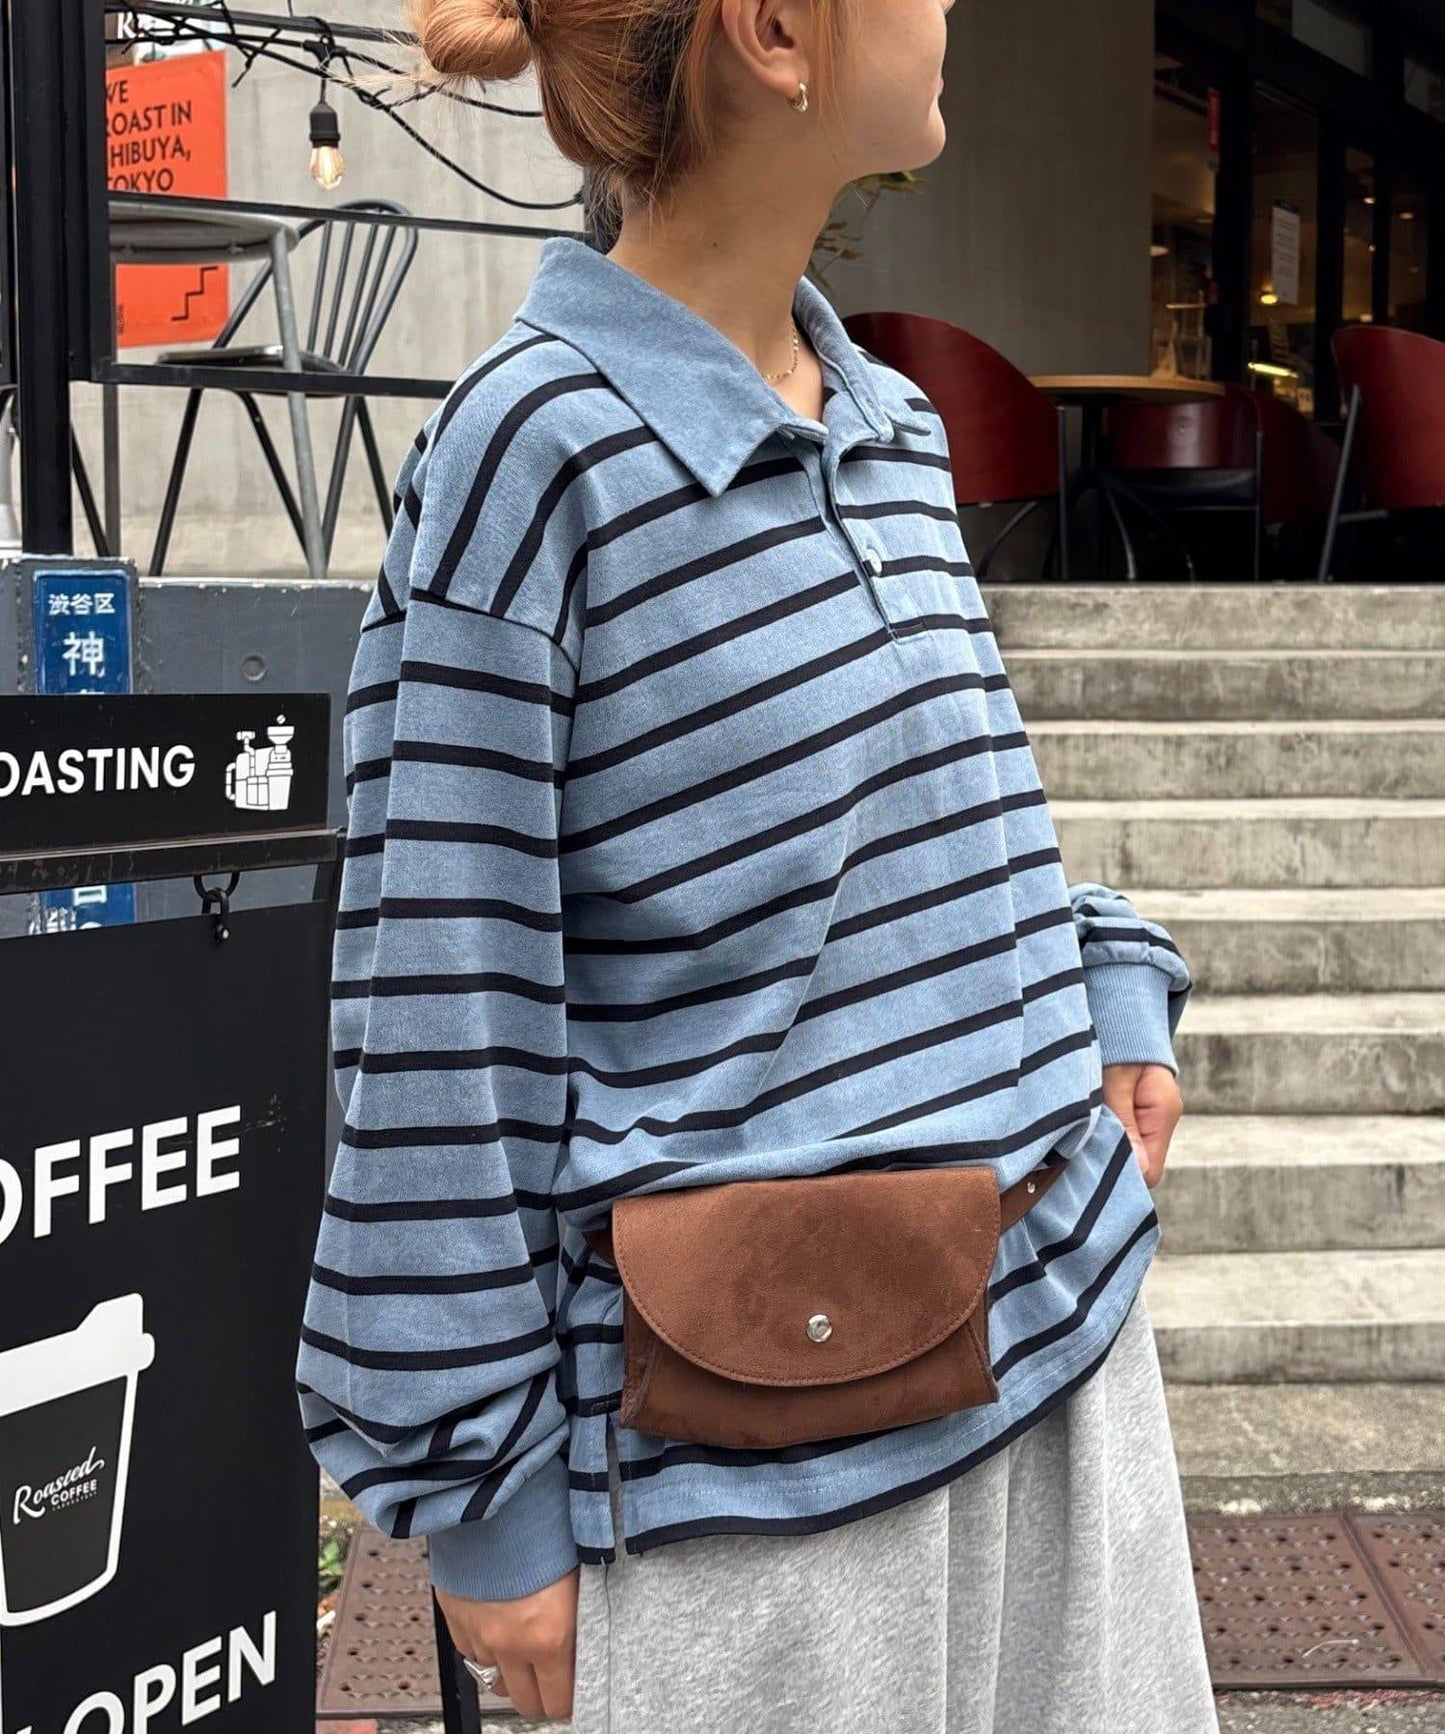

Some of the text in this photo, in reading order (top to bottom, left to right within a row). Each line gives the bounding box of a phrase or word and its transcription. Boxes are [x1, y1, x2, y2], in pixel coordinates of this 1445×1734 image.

[107, 100, 192, 136] OAST IN
[109, 135, 190, 167] HIBUYA,
[107, 168, 174, 192] OKYO
[48, 593, 115, 615] 渋谷区
[62, 631, 105, 694] 神
[13, 1446, 105, 1525] Roasted
[51, 1479, 97, 1506] COFFEE
